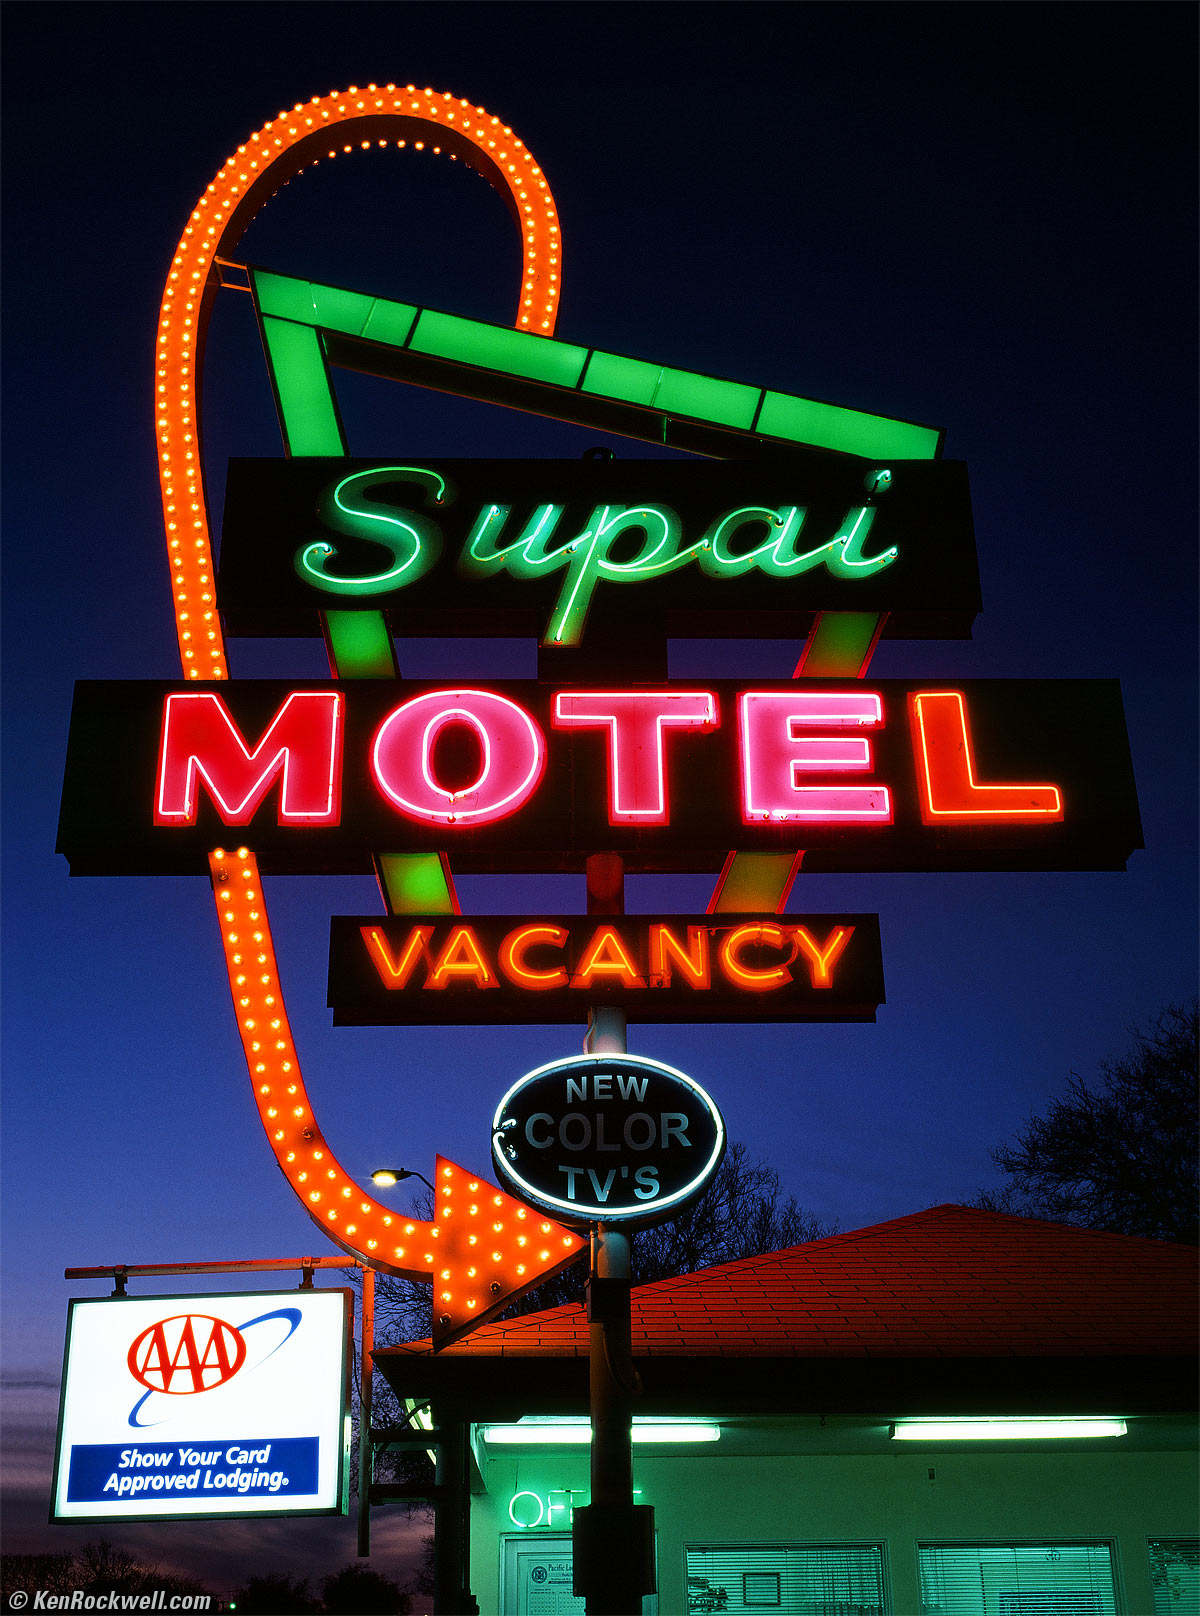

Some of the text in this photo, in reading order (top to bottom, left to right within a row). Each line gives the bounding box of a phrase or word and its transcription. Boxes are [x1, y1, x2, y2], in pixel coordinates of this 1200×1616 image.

[295, 465, 900, 647] Supai
[154, 690, 1063, 826] MOTEL
[360, 922, 856, 991] VACANCY
[565, 1074, 649, 1103] NEW
[524, 1112, 692, 1152] COLOR
[559, 1165, 660, 1201] TV'S
[134, 1315, 242, 1393] AAA
[118, 1445, 271, 1468] Show Your Card
[103, 1469, 200, 1495] Approved
